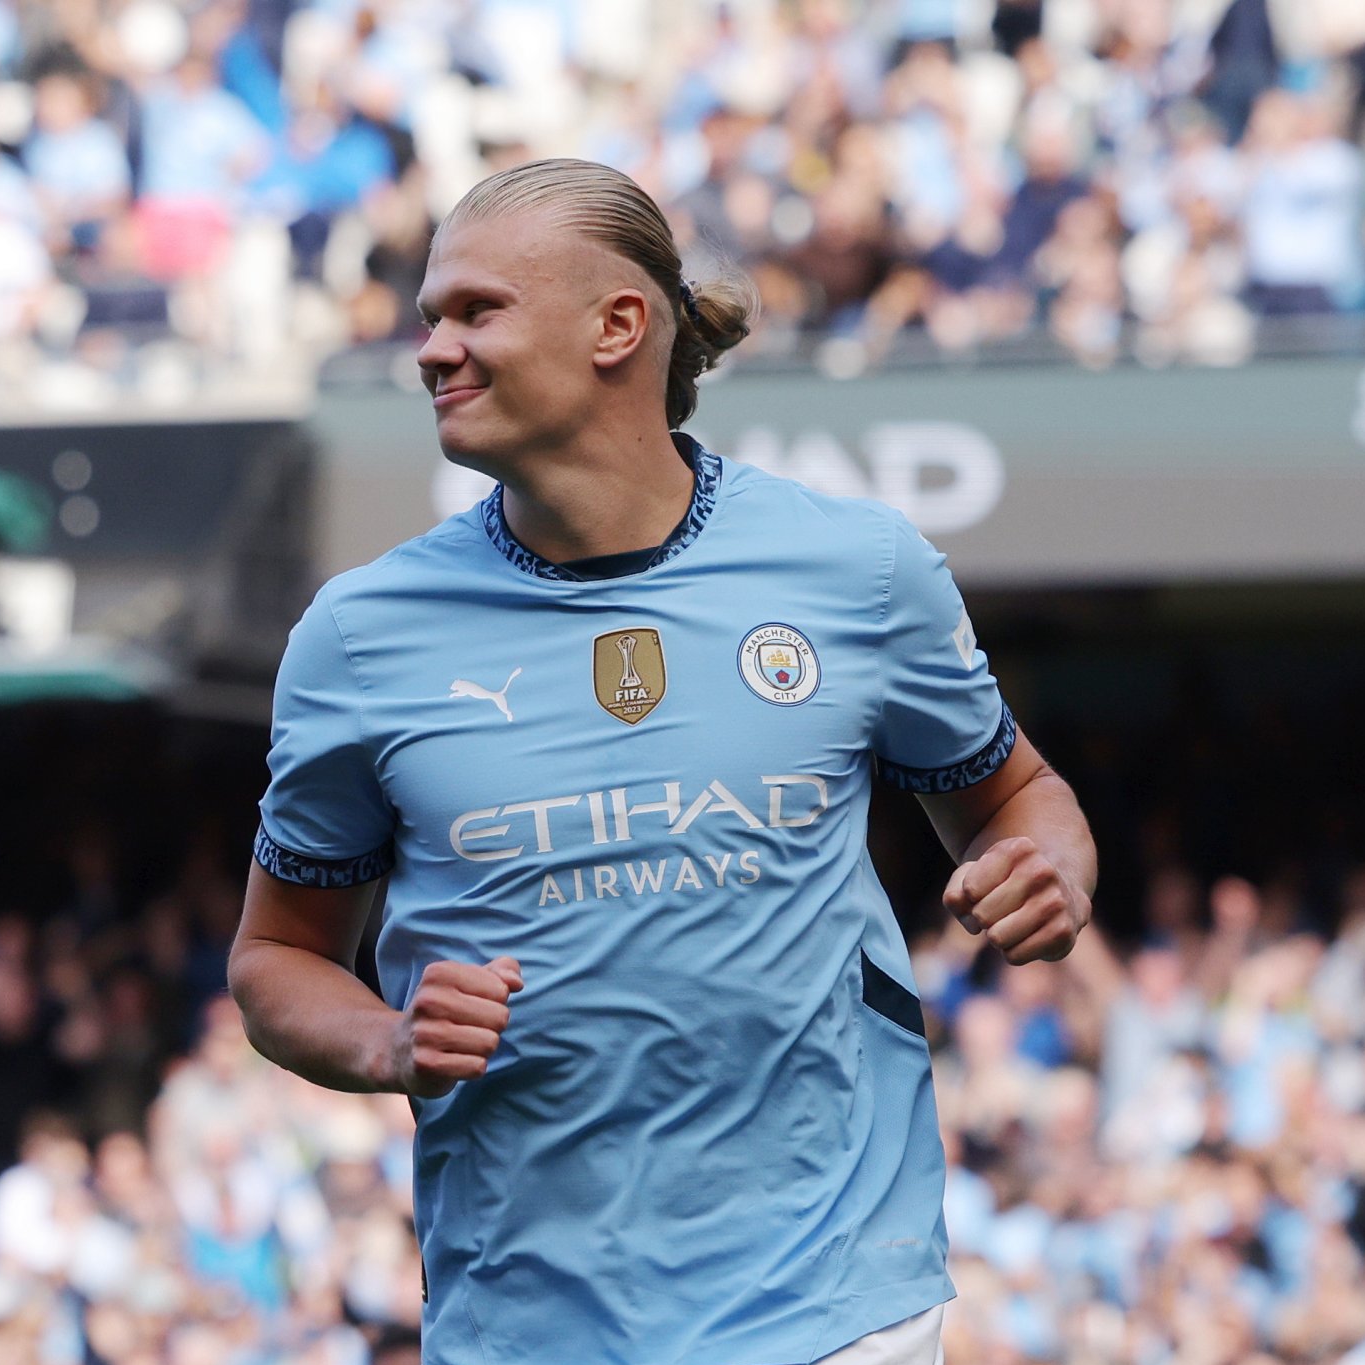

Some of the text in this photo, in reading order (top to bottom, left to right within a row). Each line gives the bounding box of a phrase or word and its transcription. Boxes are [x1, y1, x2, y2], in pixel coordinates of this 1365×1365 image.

[746, 630, 809, 656] MANCHESTER
[615, 688, 648, 702] FIFA
[774, 692, 797, 700] CITY
[623, 706, 641, 715] 2023
[449, 775, 828, 862] ETIHAD
[539, 850, 761, 906] AIRWAYS
